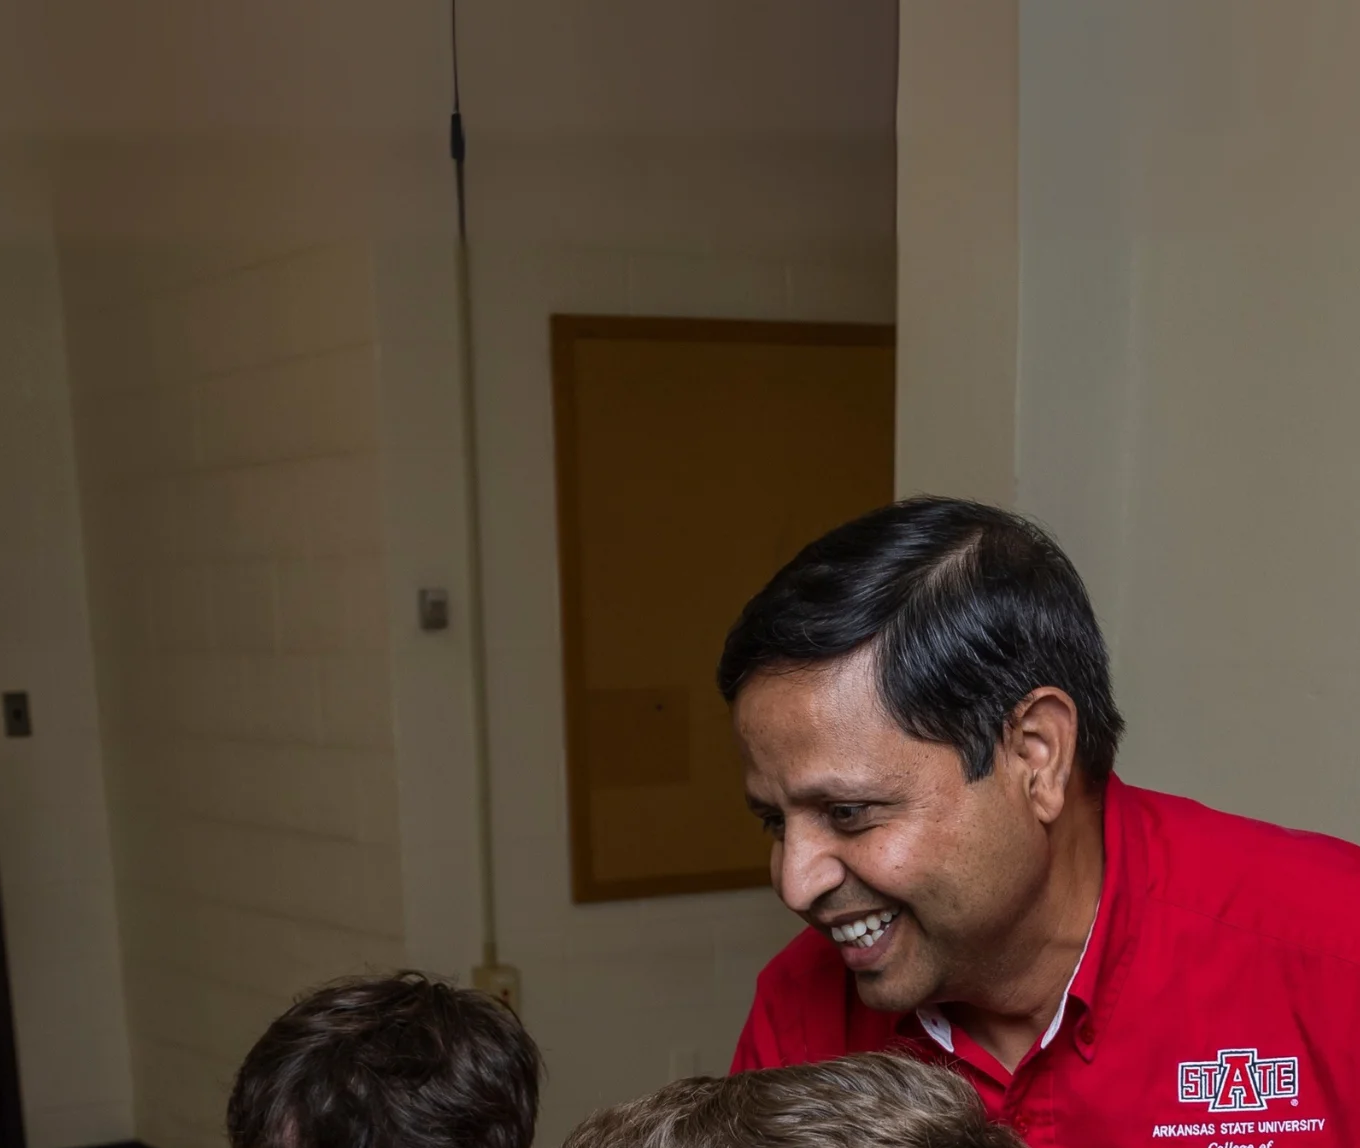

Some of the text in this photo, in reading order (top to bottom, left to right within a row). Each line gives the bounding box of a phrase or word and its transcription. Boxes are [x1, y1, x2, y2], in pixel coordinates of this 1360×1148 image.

[1178, 1048, 1298, 1112] STATE
[1152, 1118, 1325, 1138] ARKANSAS STATE UNIVERSITY
